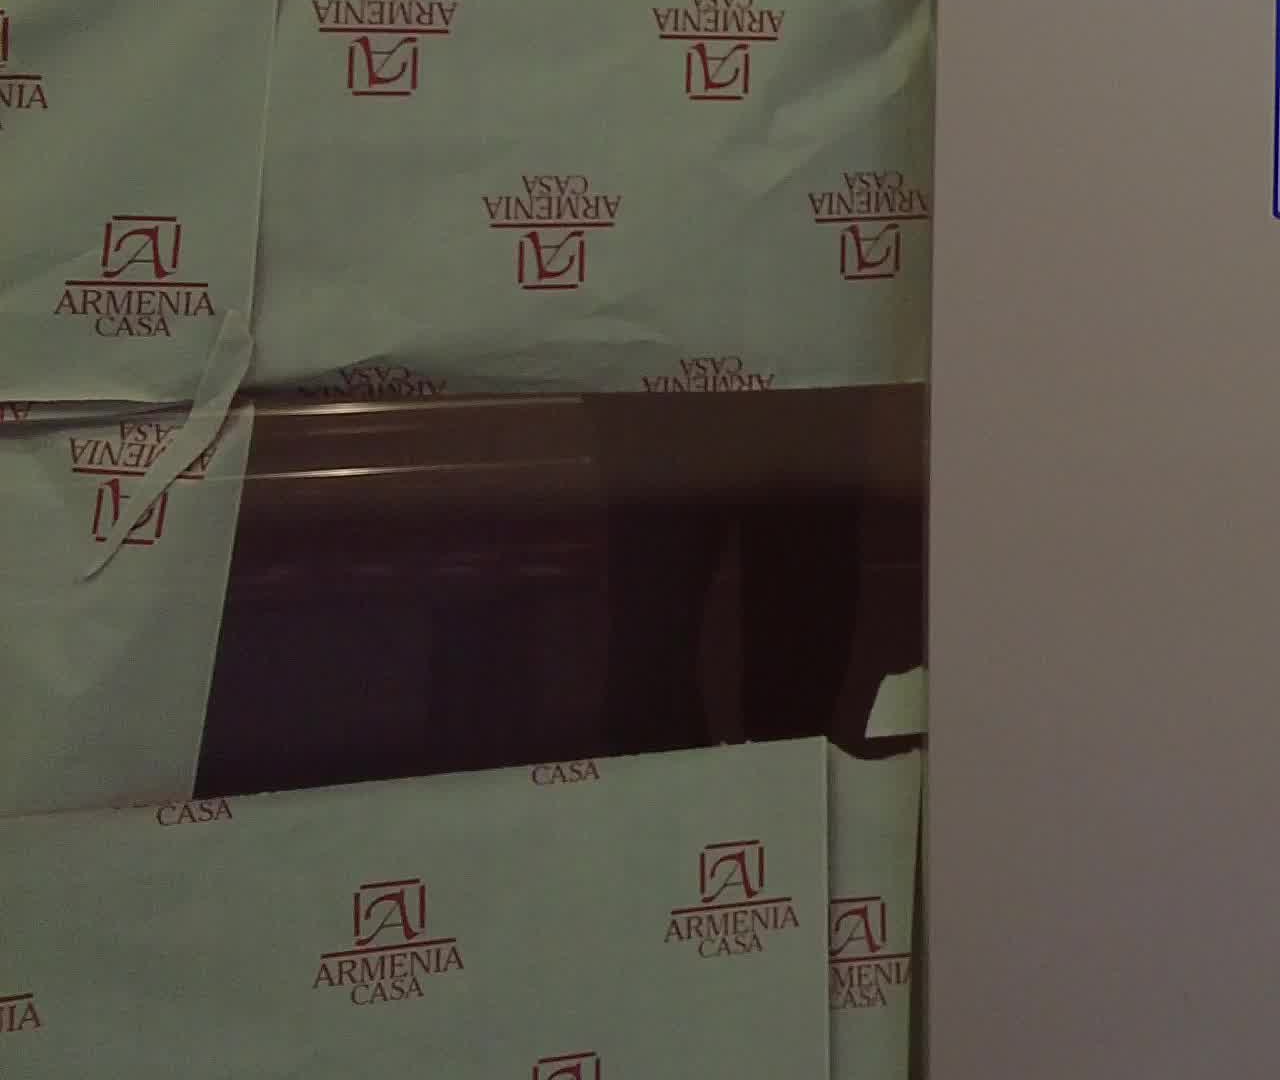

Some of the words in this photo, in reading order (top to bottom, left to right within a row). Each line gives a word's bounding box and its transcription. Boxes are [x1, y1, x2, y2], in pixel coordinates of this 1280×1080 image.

[312, 0, 457, 27] ARMENIA
[652, 6, 784, 35] ARMENIA
[521, 175, 588, 196] CASA
[843, 170, 904, 189] CASA
[482, 193, 621, 221] ARMENIA
[55, 289, 216, 317] ARMENIA
[95, 316, 171, 339] CASA
[679, 356, 742, 378] CASA
[120, 424, 182, 442] ASA
[531, 760, 600, 787] CASA
[155, 799, 234, 828] CASA
[664, 902, 800, 944] ARMENIA
[698, 929, 763, 958] CASA
[313, 944, 465, 988] ARMENIA
[350, 976, 424, 1005] CASA
